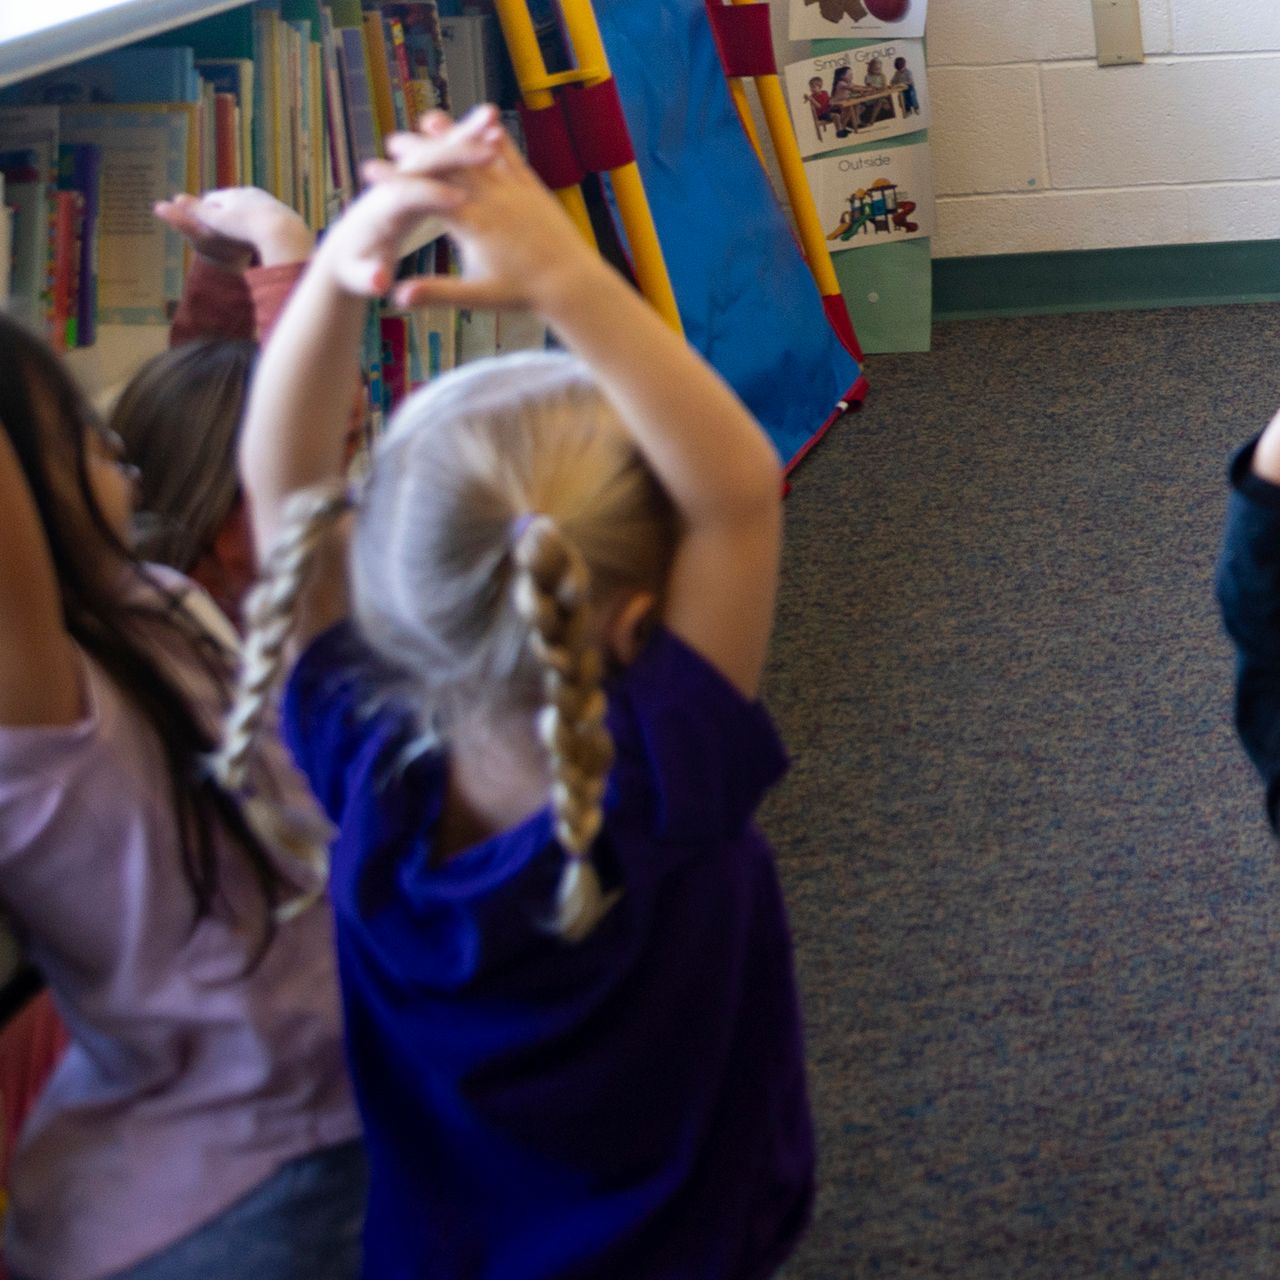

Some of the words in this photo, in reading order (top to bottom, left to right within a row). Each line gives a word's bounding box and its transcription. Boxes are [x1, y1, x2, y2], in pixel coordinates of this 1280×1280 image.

[814, 56, 852, 72] Small
[854, 45, 897, 64] Group
[838, 154, 891, 172] Outside
